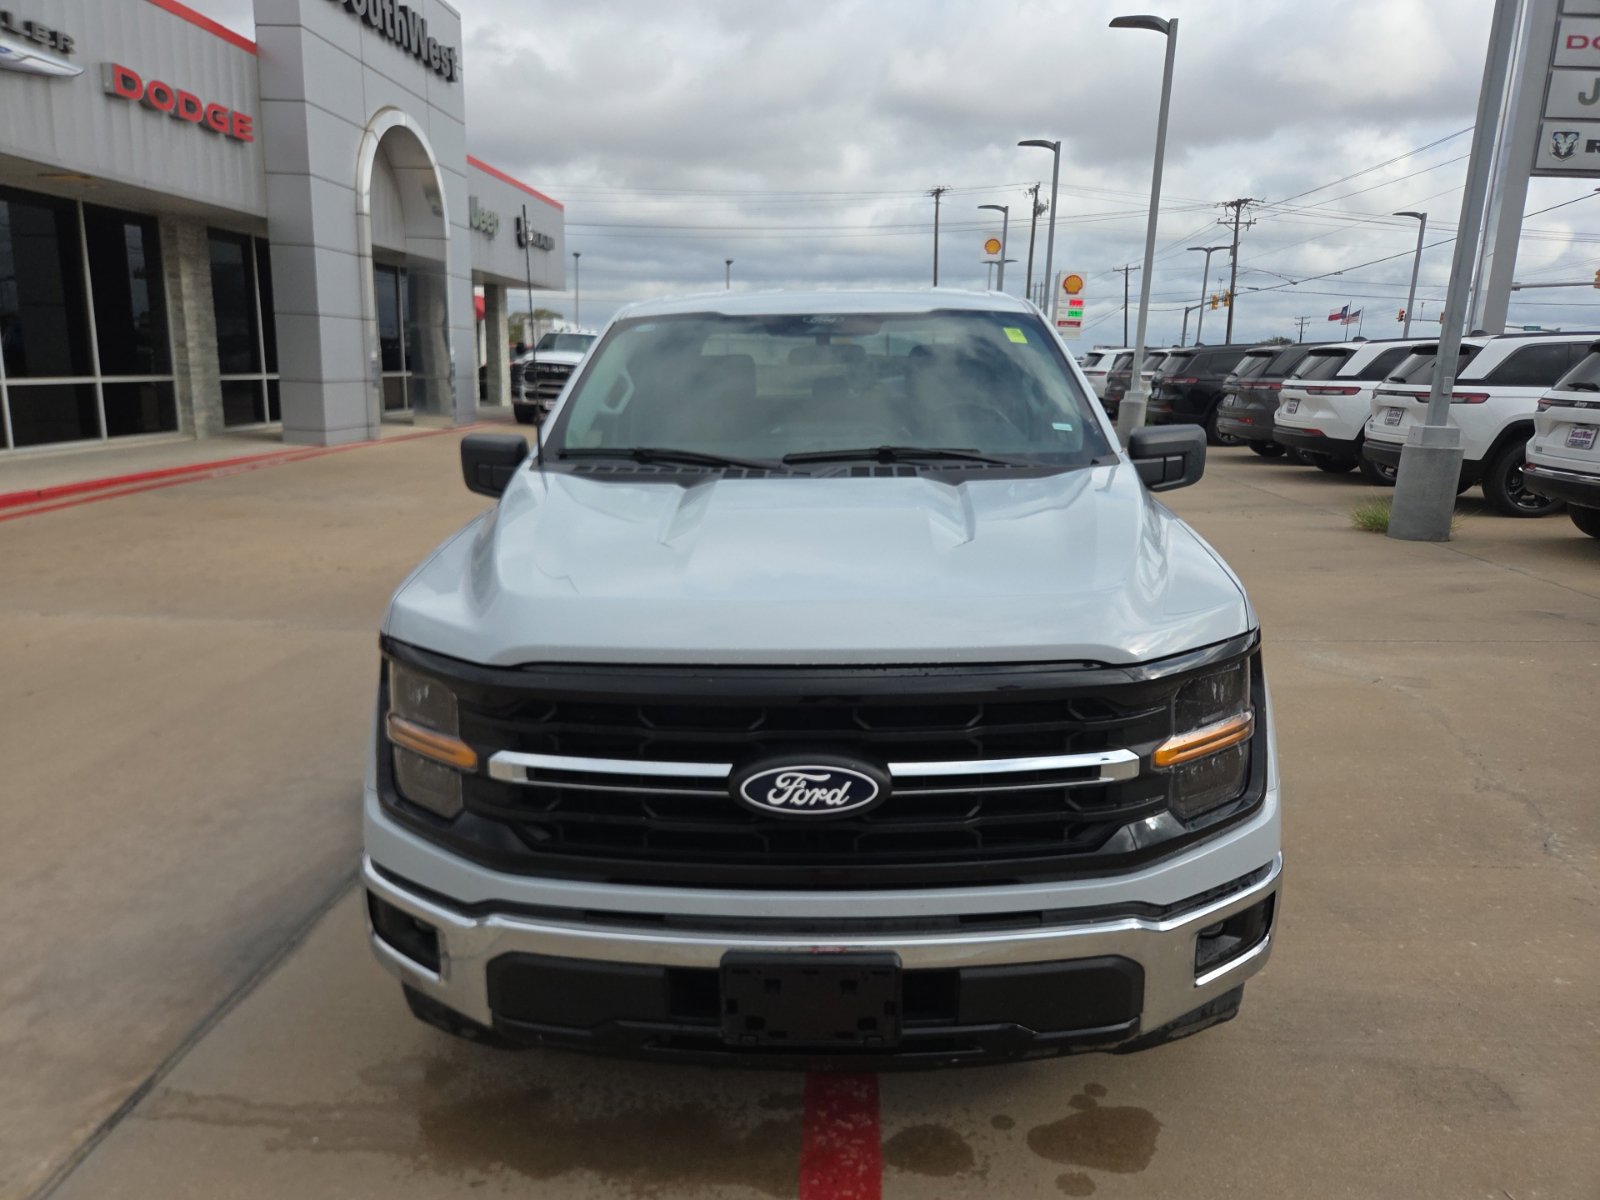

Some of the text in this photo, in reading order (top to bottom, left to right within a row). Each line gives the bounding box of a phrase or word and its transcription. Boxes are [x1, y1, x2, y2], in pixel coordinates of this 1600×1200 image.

[0, 10, 76, 55] LER
[330, 0, 458, 83] uthWest
[110, 63, 254, 143] DODGE
[766, 772, 852, 806] Ford
